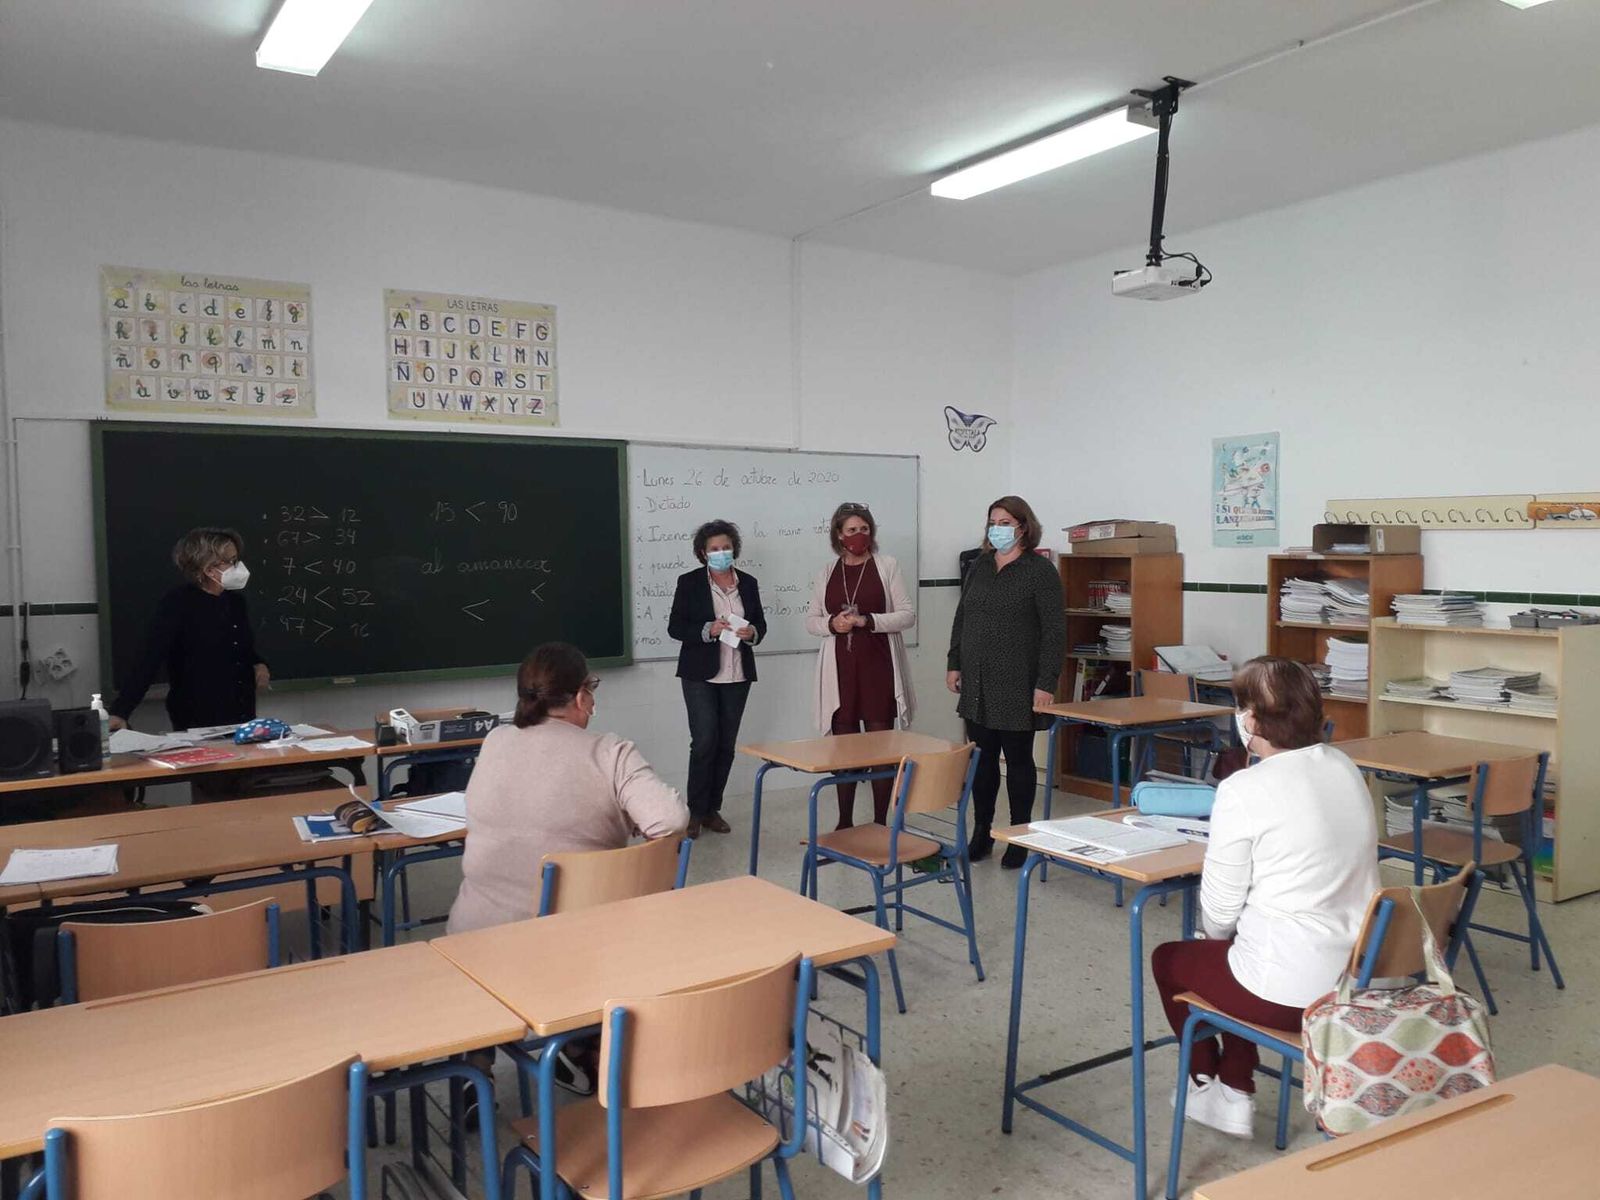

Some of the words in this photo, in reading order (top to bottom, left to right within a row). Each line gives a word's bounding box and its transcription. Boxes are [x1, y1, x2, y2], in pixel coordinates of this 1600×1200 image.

[181, 276, 199, 289] las
[204, 277, 240, 292] letras
[114, 298, 128, 309] a
[145, 293, 157, 311] b
[178, 303, 187, 314] c
[204, 299, 219, 316] d
[235, 308, 246, 319] e
[289, 305, 300, 323] g
[447, 299, 464, 309] LAS
[466, 300, 499, 313] LETRAS
[116, 321, 129, 340] h
[179, 325, 188, 344] j
[207, 329, 222, 346] k
[234, 331, 244, 347] l
[262, 336, 276, 350] m
[291, 340, 303, 351] n
[393, 312, 407, 329] A
[419, 314, 430, 330] B
[443, 317, 456, 332] C
[469, 319, 480, 335] D
[491, 321, 502, 336] E
[517, 323, 527, 339] F
[536, 325, 548, 341] G
[394, 338, 407, 355] H
[447, 343, 456, 359] J
[470, 344, 480, 360] K
[493, 346, 501, 362] L
[515, 348, 526, 363] M
[537, 350, 549, 366] N
[150, 359, 160, 369] o
[179, 353, 193, 371] p
[207, 357, 220, 374] q
[292, 360, 301, 376] t
[397, 362, 410, 381] Ñ
[423, 367, 435, 382] O
[450, 368, 458, 383] P
[469, 370, 482, 386] Q
[495, 371, 504, 387] R
[515, 374, 526, 389] S
[536, 375, 547, 390] T
[136, 385, 151, 398] u
[225, 388, 236, 402] x
[254, 386, 265, 403] y
[282, 393, 293, 404] z
[413, 392, 425, 408] U
[438, 393, 449, 409] V
[460, 395, 473, 410] W
[484, 396, 495, 411] X
[507, 397, 519, 412] Y
[531, 399, 542, 414] Z
[642, 467, 675, 487] Lunes
[683, 467, 702, 487] 26
[713, 467, 730, 487] de
[787, 469, 801, 486] de
[808, 471, 841, 484] 2020
[280, 505, 306, 522] 32
[341, 507, 362, 524] 12
[498, 501, 519, 524] 90
[646, 496, 691, 513] Dictado
[277, 530, 300, 546] 67
[282, 557, 297, 576] 7
[333, 559, 357, 575] 40
[277, 585, 307, 606] 24
[474, 719, 494, 732] A4
